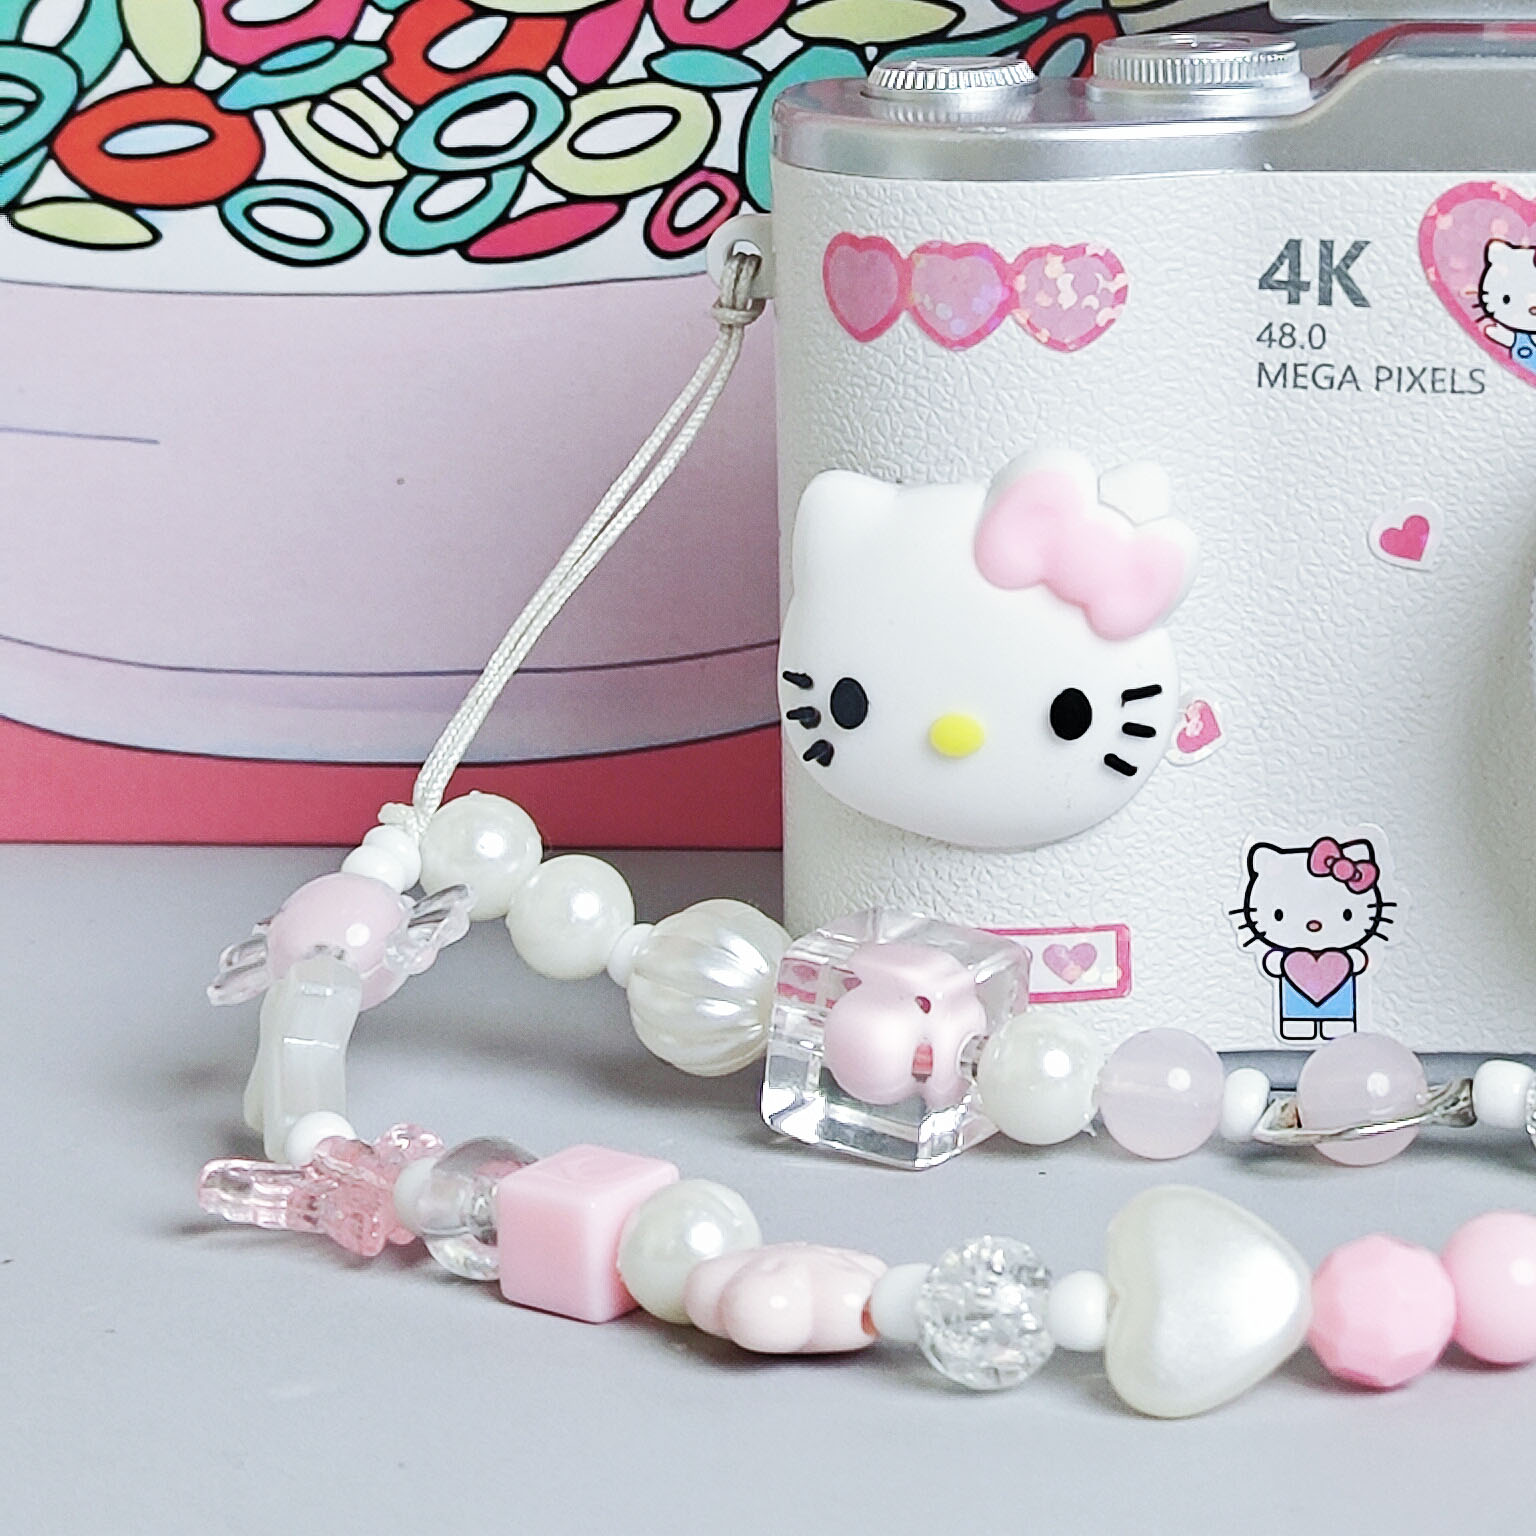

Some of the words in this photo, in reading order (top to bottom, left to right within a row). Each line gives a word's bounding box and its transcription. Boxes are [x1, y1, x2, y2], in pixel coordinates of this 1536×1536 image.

[1257, 238, 1371, 308] 4K
[1256, 322, 1327, 350] 48.0
[1256, 362, 1362, 392] MEGA
[1374, 366, 1486, 395] PIXELS
